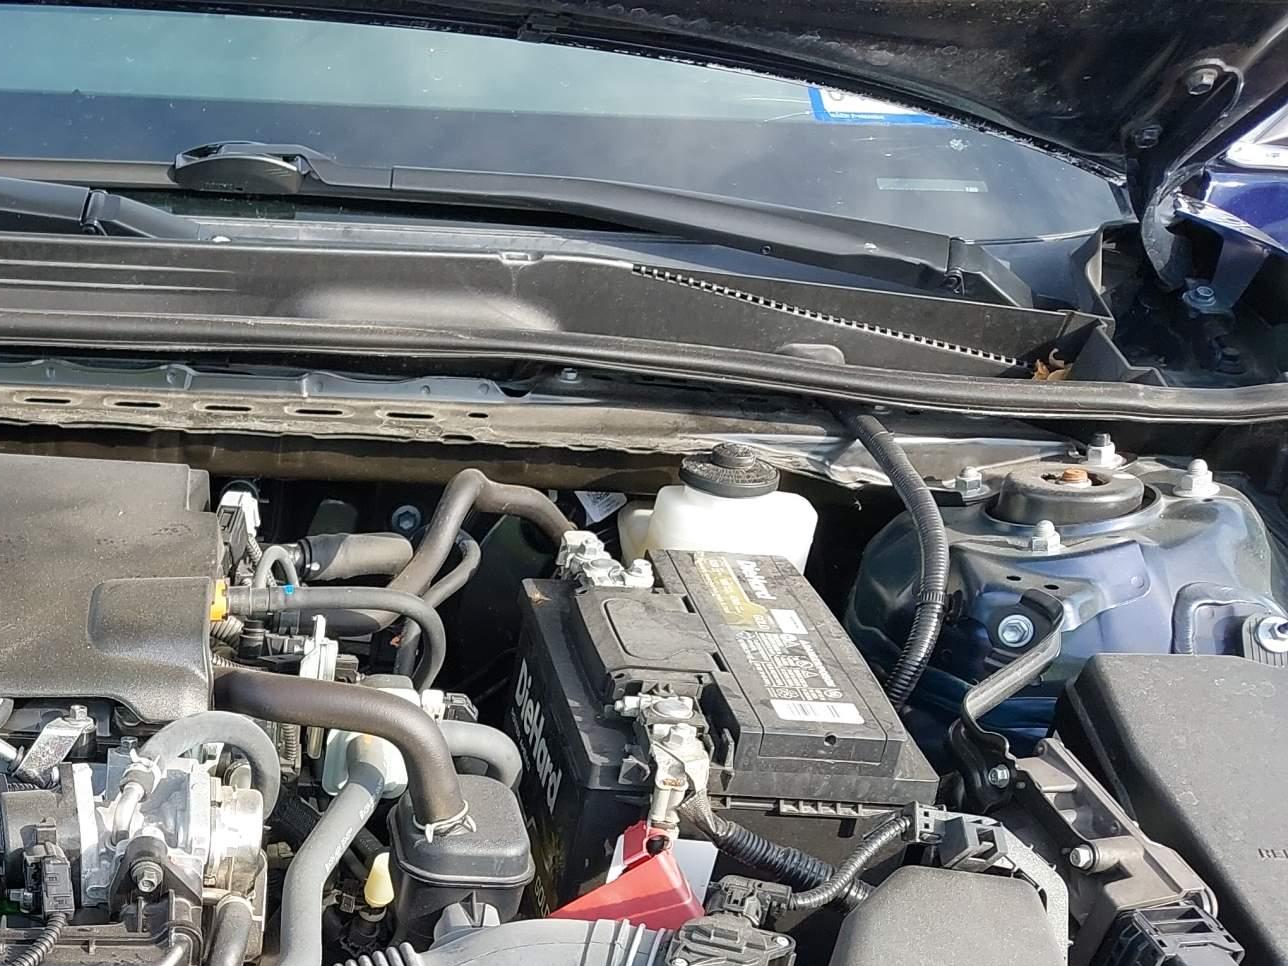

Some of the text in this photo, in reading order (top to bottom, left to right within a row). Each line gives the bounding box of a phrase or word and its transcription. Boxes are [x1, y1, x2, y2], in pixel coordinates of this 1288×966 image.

[736, 559, 777, 600] DieHard
[753, 613, 771, 631] GOLD
[514, 657, 563, 813] DieHard
